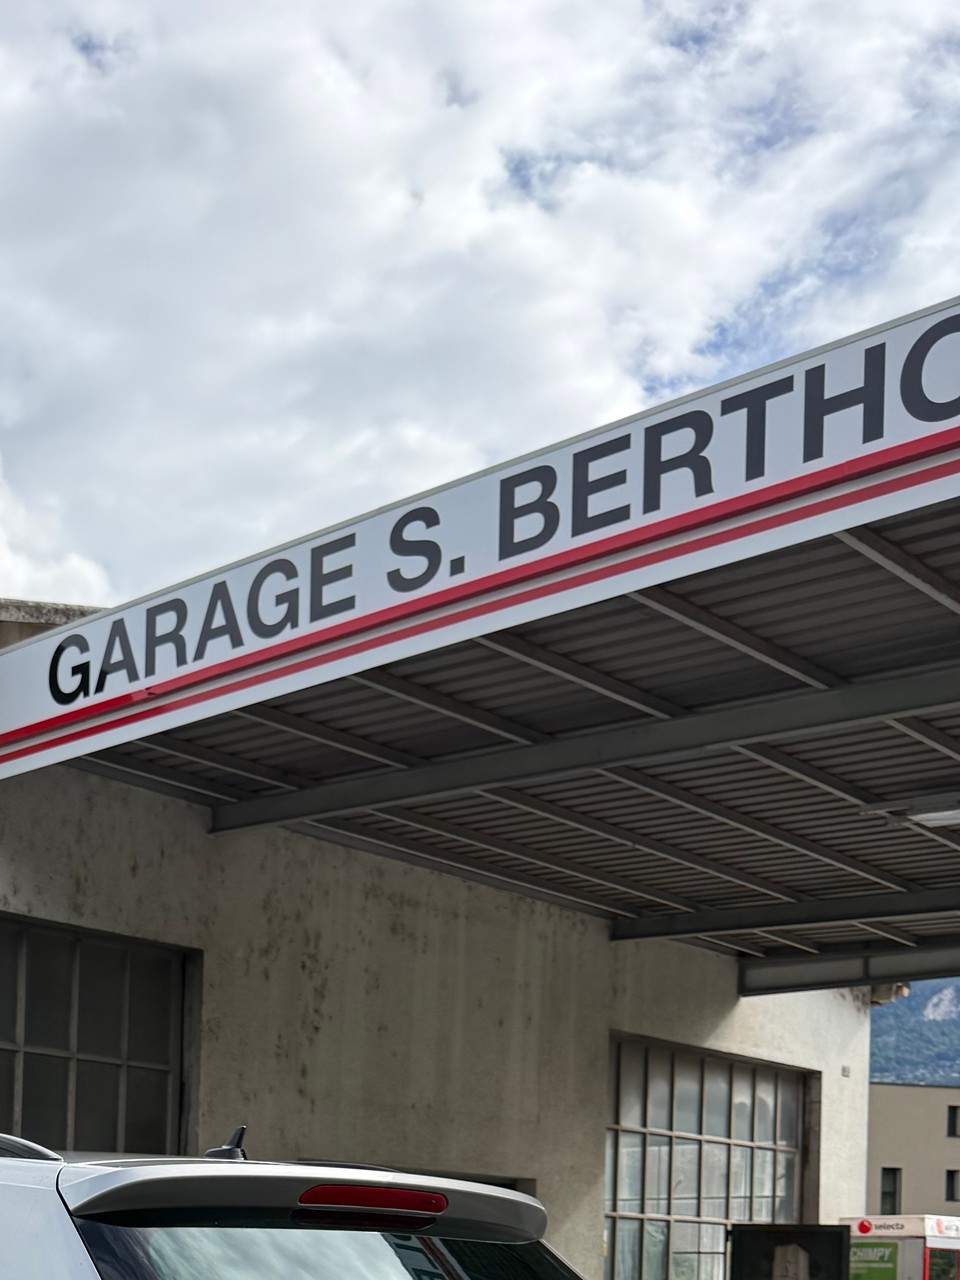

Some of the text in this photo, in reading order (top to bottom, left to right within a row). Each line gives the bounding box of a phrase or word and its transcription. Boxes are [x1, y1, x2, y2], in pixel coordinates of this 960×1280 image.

[48, 313, 960, 706] GARAGE S. BERTHO
[874, 1221, 905, 1231] selecta
